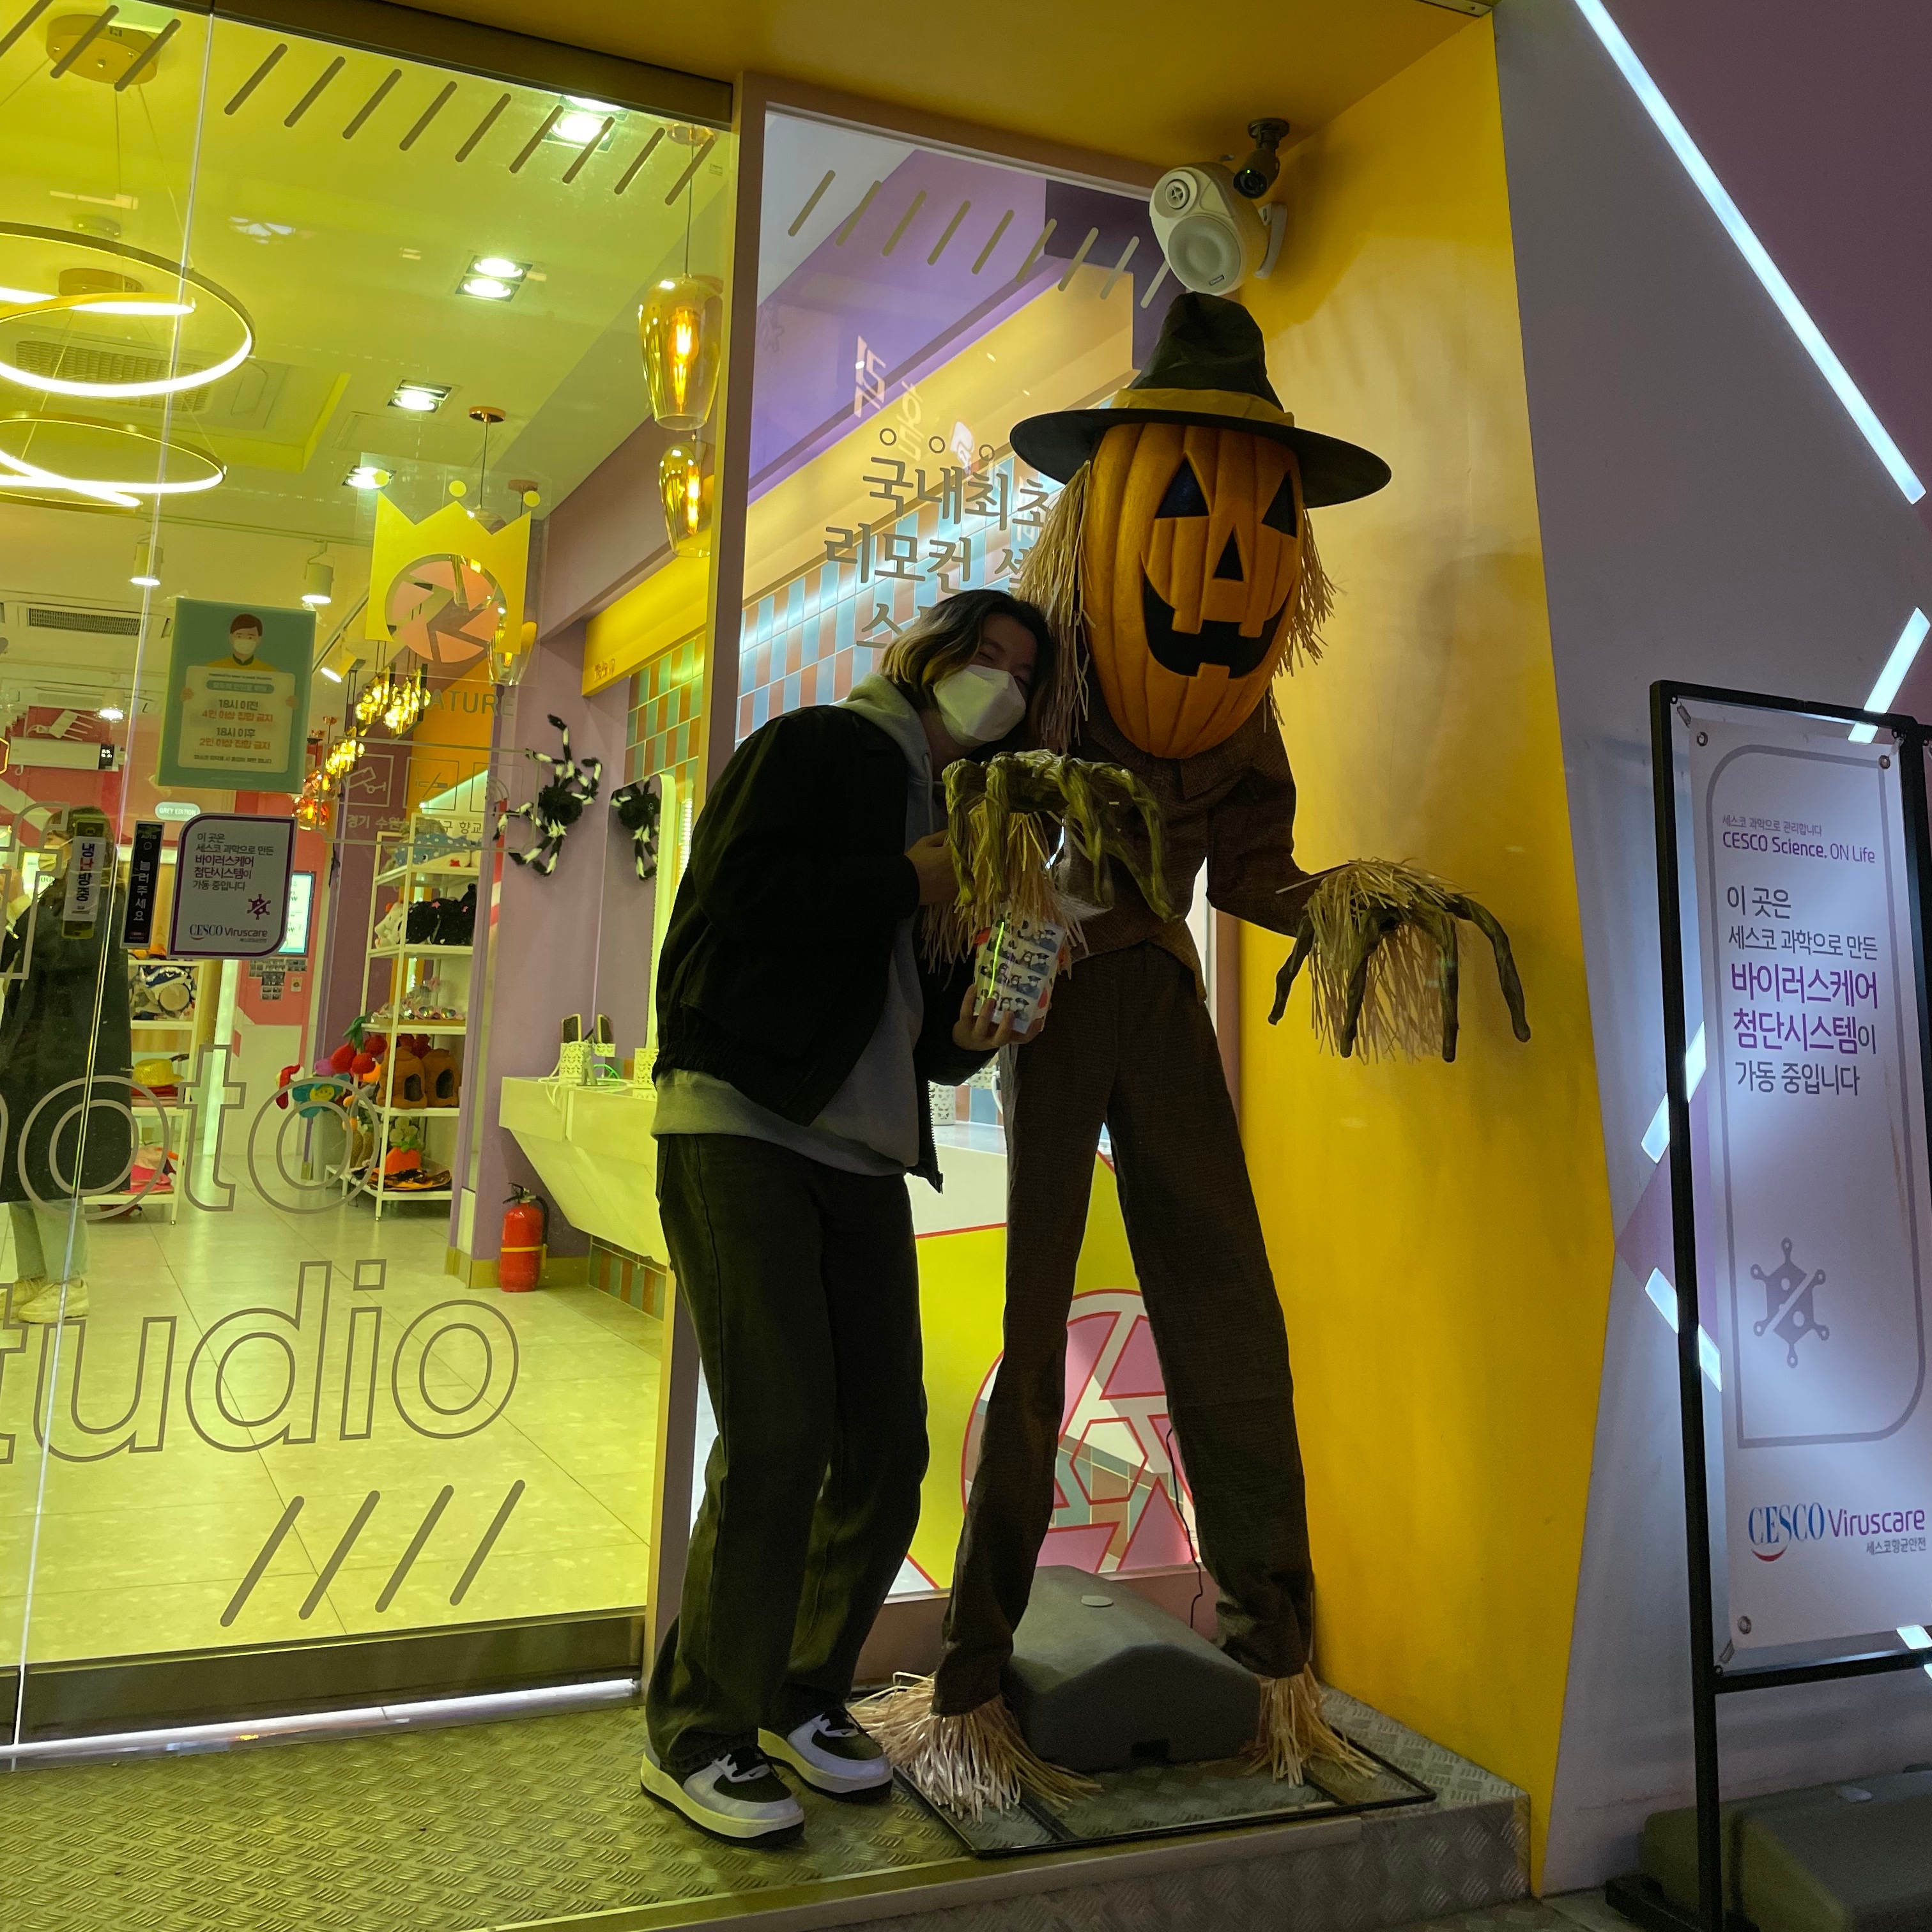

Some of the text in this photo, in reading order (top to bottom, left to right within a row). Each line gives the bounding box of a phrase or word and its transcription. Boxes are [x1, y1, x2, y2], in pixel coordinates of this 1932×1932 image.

[862, 457, 1051, 531] 국내최초
[824, 523, 972, 595] 리모컨
[219, 700, 258, 711] 18시 이전
[202, 710, 273, 723] 4인 이상 집합 금지
[216, 727, 256, 738] 18시 이후
[199, 738, 270, 750] 2인 이상 집합 금지
[347, 815, 370, 829] 경기
[1722, 815, 1823, 837] 세스코 과학으로 관리합니다
[197, 832, 226, 843] 이 곳은
[1722, 831, 1876, 862] CESCO Science. ON Life
[195, 843, 274, 856] 세스코 과학으로 만든
[77, 843, 95, 901] 냉난방중
[195, 855, 254, 868] 바이러스케어
[194, 867, 252, 880] 첨단시스템이
[193, 880, 246, 891] 가동 중입니다
[1727, 885, 1791, 919] 이 곳은
[189, 924, 268, 937] CESCO Viruscare
[1728, 925, 1878, 960] 세스코 과학으로 만든
[1731, 962, 1878, 1009] 바이러스케어
[1733, 1008, 1876, 1055] 첨단시스템이
[1735, 1060, 1860, 1096] 가동 중입니다
[0, 1043, 381, 1220] oto
[1748, 1502, 1926, 1545] CESCO Viruscare
[1866, 1536, 1926, 1556] 세스코항균안전
